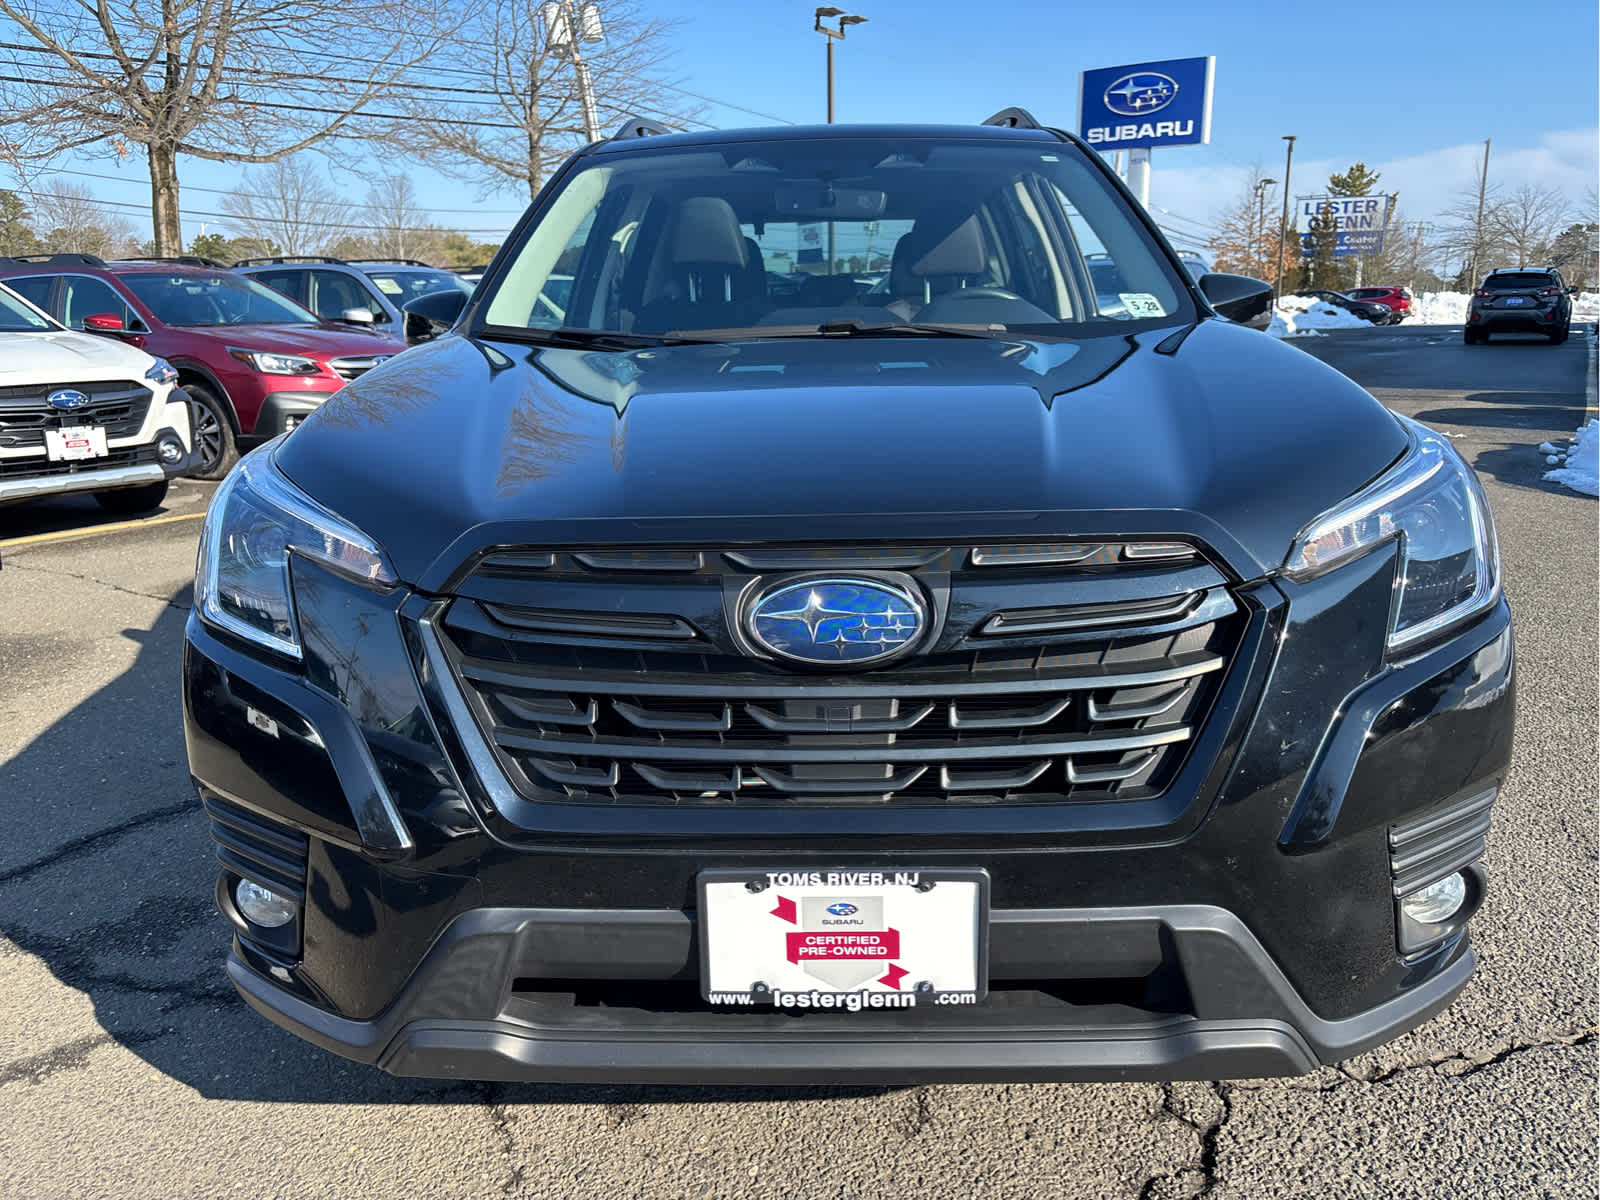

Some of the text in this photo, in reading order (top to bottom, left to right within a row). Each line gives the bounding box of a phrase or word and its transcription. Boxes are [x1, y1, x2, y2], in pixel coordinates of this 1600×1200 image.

[1087, 120, 1194, 143] SUBARU
[1304, 200, 1378, 215] LESTER
[766, 872, 823, 886] TOMS
[895, 872, 920, 886] NJ
[805, 936, 881, 946] CERTIFIED
[798, 946, 888, 956] PRE-OWNED
[774, 990, 917, 1012] lesterglenn
